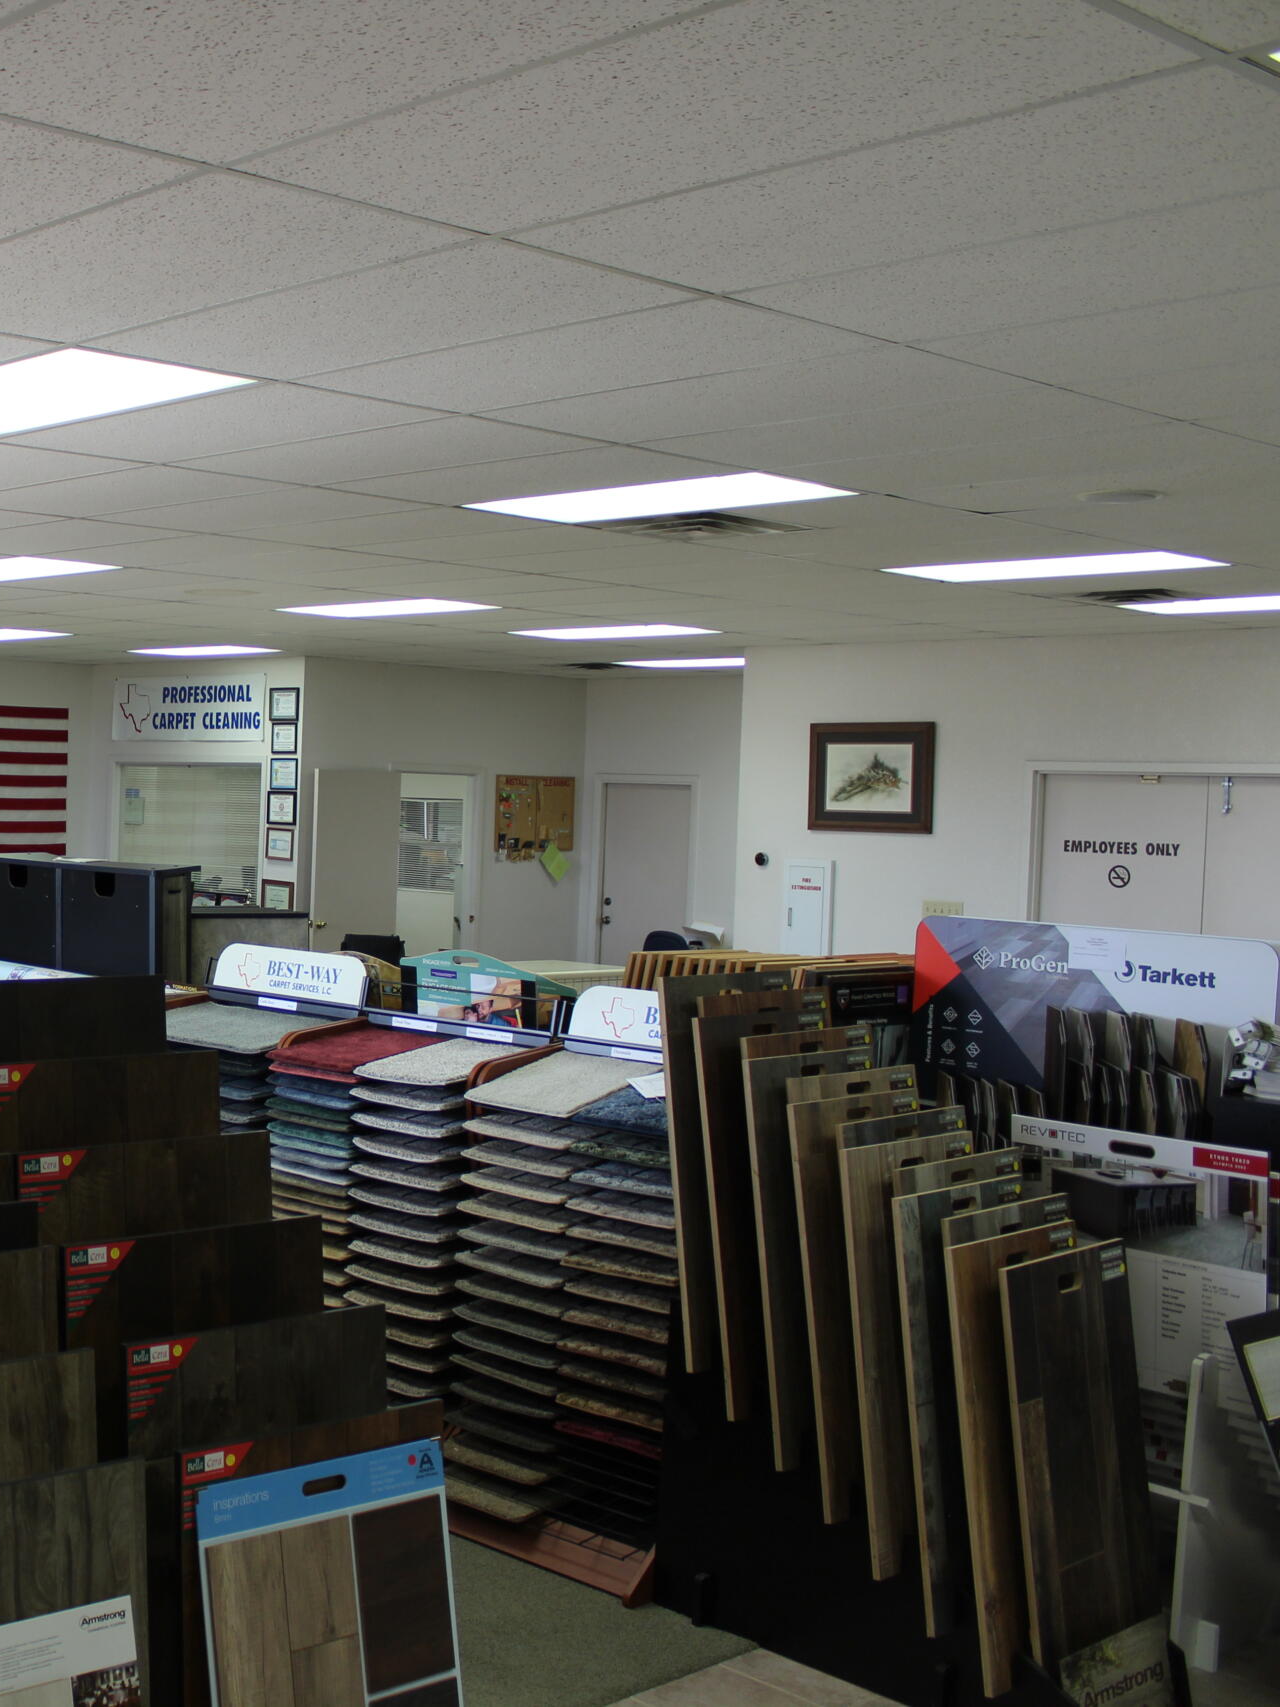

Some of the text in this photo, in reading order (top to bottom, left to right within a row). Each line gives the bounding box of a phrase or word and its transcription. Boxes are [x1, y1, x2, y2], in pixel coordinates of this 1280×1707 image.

[162, 684, 253, 704] PROFESSIONAL
[152, 711, 261, 730] CARPET CLEANING
[1063, 839, 1181, 857] EMPLOYEES ONLY
[999, 951, 1068, 974] ProGen
[266, 960, 342, 985] BEST-WAY
[1138, 964, 1216, 989] Tarkett
[268, 979, 291, 990] CARPET
[133, 1346, 150, 1364] Bella
[187, 1456, 204, 1472] Bella
[213, 1490, 269, 1512] inspirations
[80, 1610, 126, 1627] Armstrong
[1082, 1662, 1164, 1707] Armstrong
